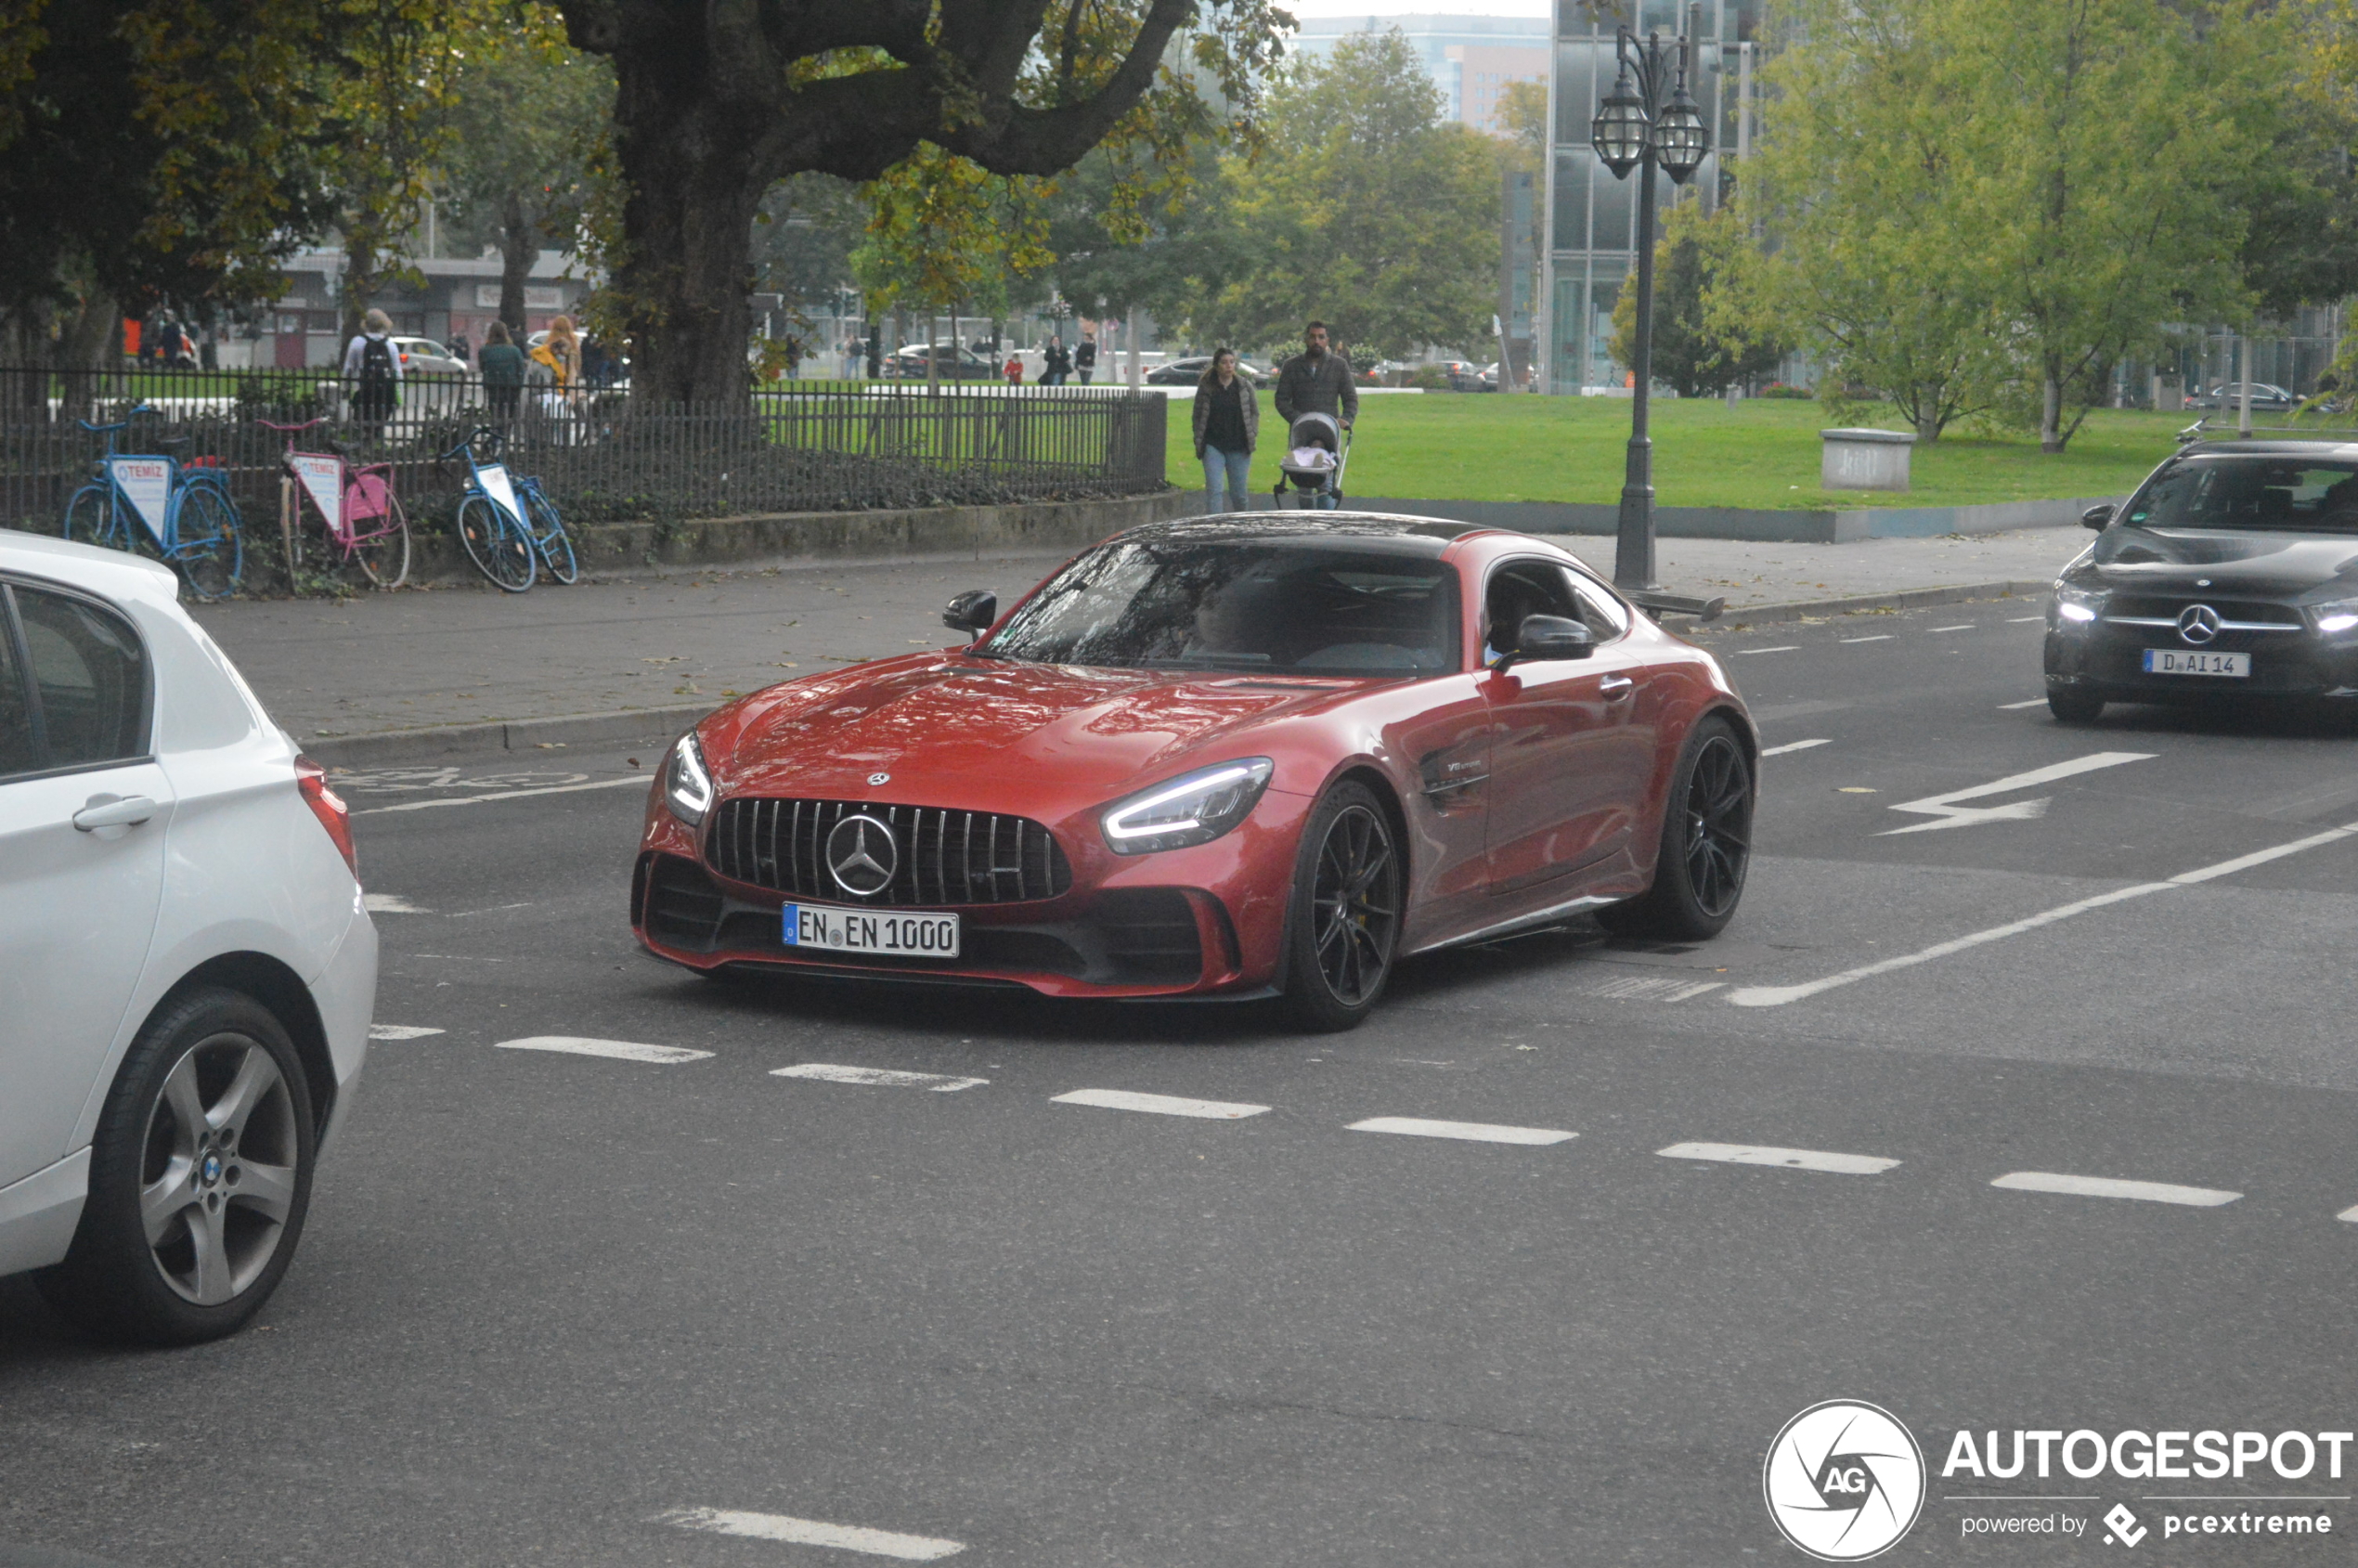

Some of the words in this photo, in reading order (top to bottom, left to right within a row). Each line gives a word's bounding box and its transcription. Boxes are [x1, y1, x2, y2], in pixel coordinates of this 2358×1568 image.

[2164, 654, 2175, 670] D
[2186, 654, 2208, 672] AI
[2212, 656, 2235, 673] 14
[798, 911, 827, 943] EN
[846, 915, 877, 949] EN
[885, 918, 953, 951] 1000
